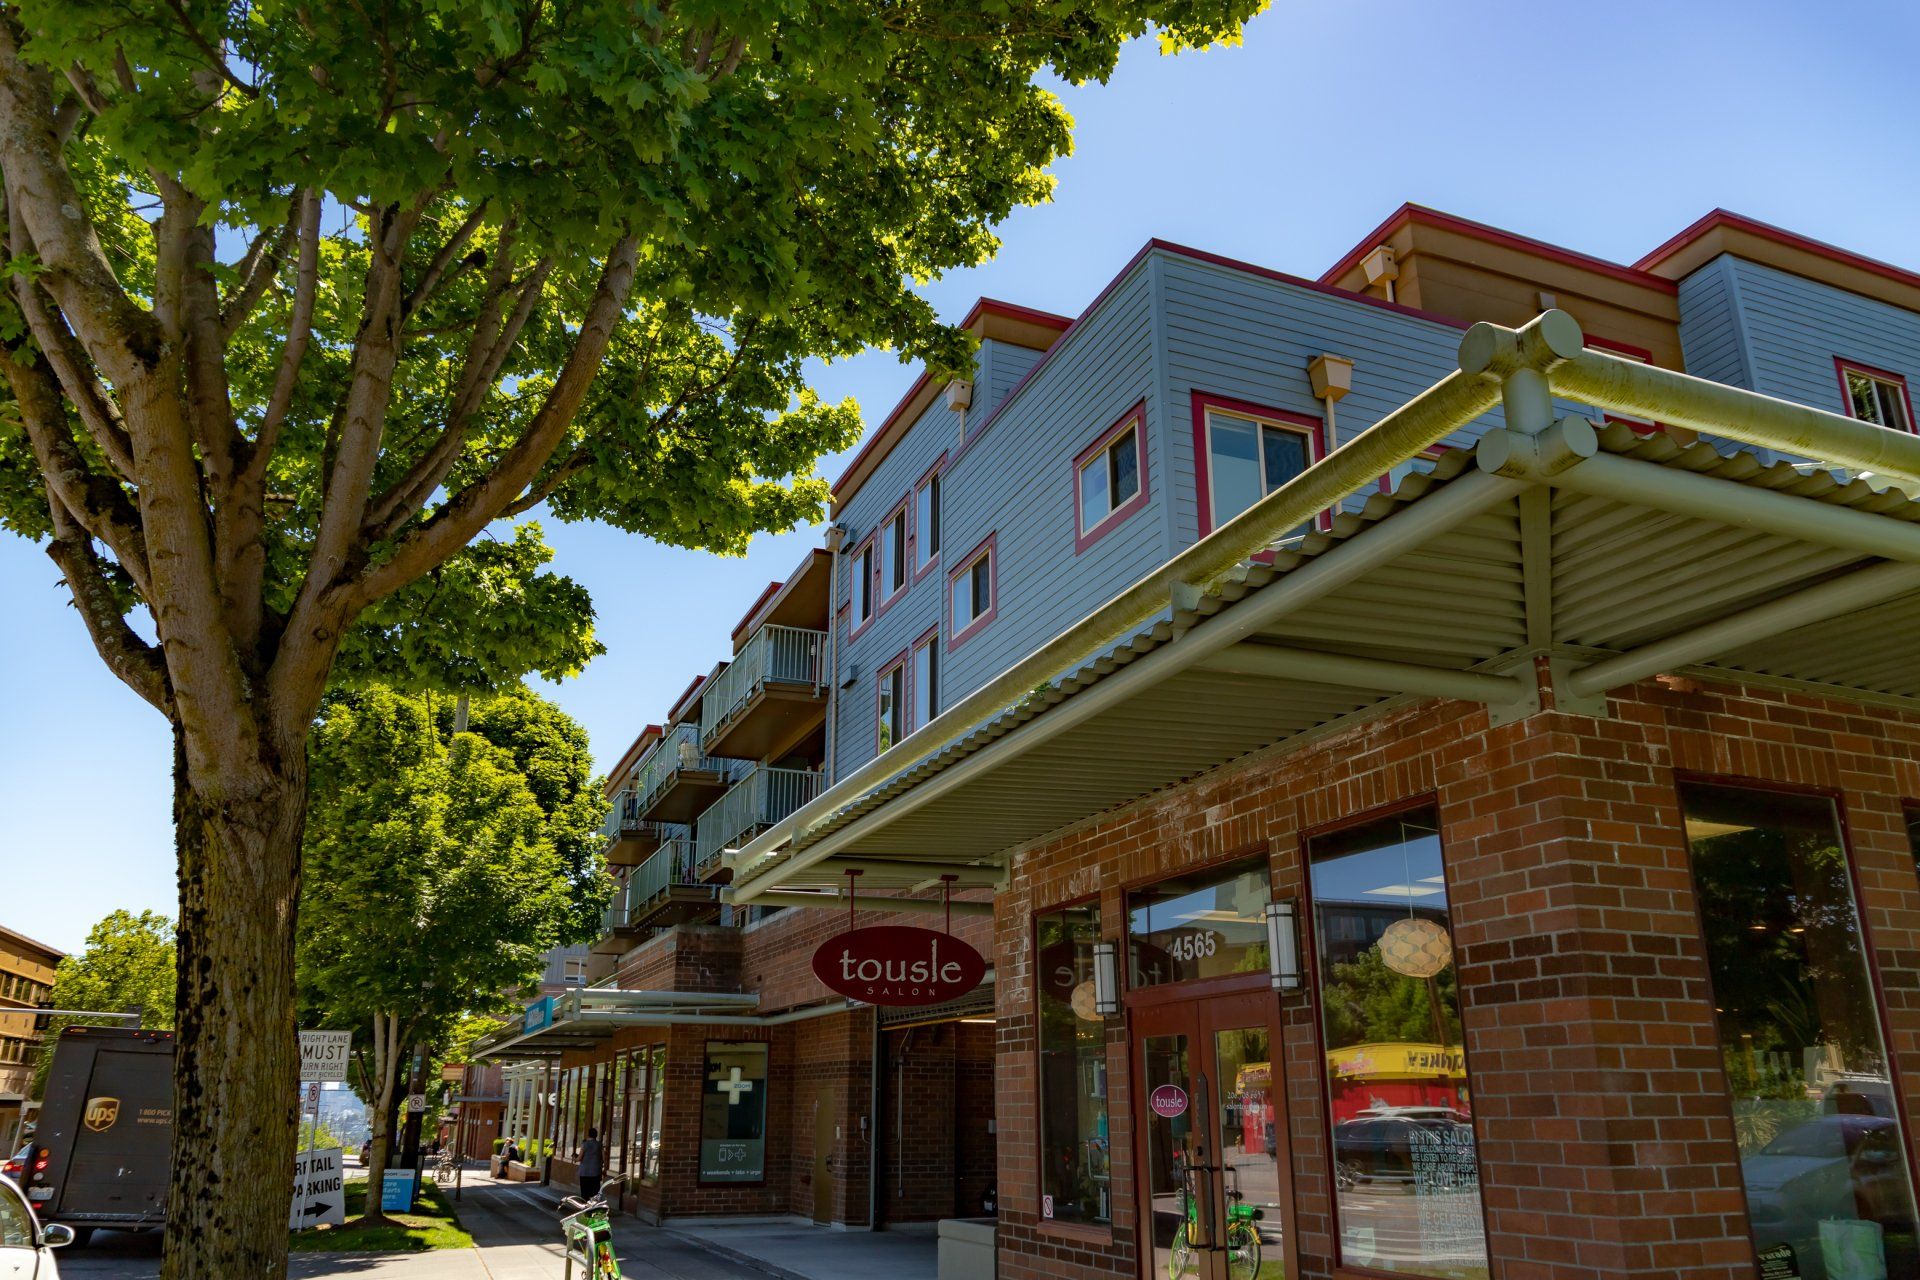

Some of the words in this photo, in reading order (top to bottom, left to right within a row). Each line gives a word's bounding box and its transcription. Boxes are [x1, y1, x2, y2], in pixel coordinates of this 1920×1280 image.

[1173, 930, 1216, 961] 4565
[839, 938, 962, 983] tousle
[866, 986, 935, 996] SALON
[327, 1035, 348, 1043] LANE
[303, 1045, 344, 1060] MUST
[320, 1062, 343, 1071] RIGHT
[1156, 1089, 1182, 1108] tousle
[87, 1107, 115, 1126] ups
[1420, 1129, 1441, 1145] THIS
[1421, 1153, 1439, 1162] LISTEN
[1457, 1163, 1477, 1173] PEOPL
[1433, 1212, 1483, 1231] CELEBRAT
